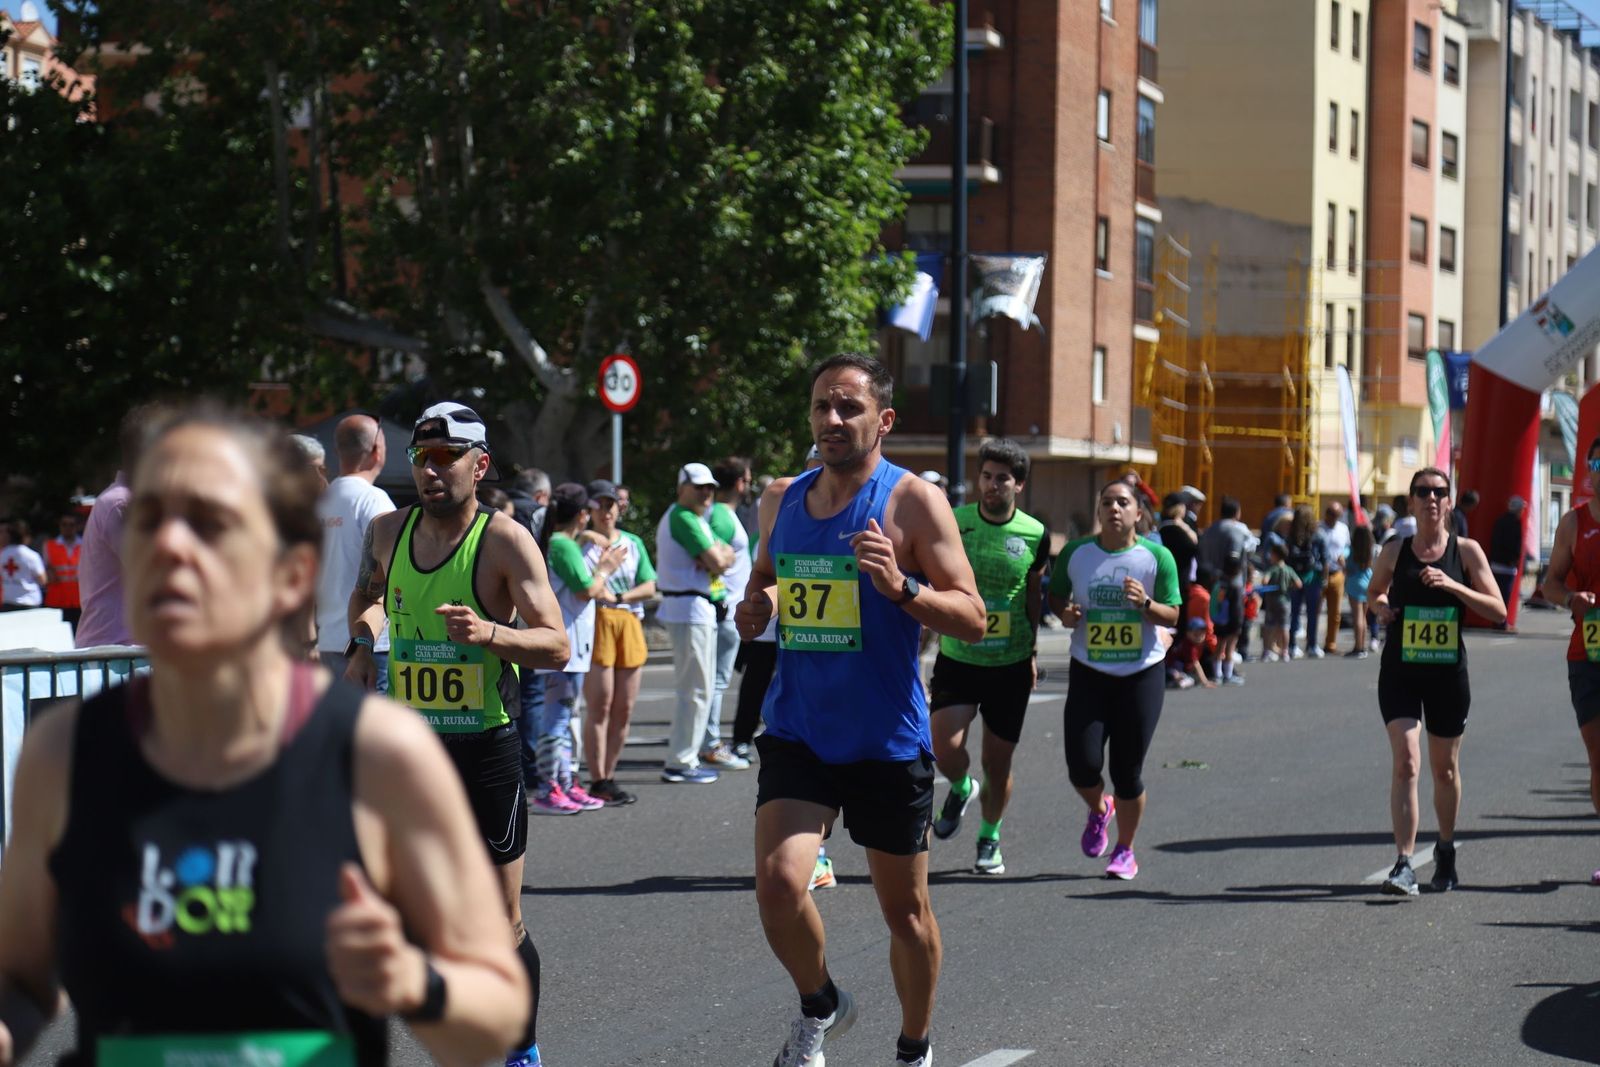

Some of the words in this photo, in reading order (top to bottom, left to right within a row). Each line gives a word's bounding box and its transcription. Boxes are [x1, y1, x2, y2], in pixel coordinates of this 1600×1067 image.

[789, 583, 832, 620] 37
[795, 633, 819, 643] CAJA
[1090, 625, 1133, 646] 246
[1407, 623, 1449, 645] 148
[415, 650, 432, 658] CAJA
[433, 651, 456, 659] RURAL
[400, 666, 464, 703] 106
[442, 715, 479, 725] RURAL
